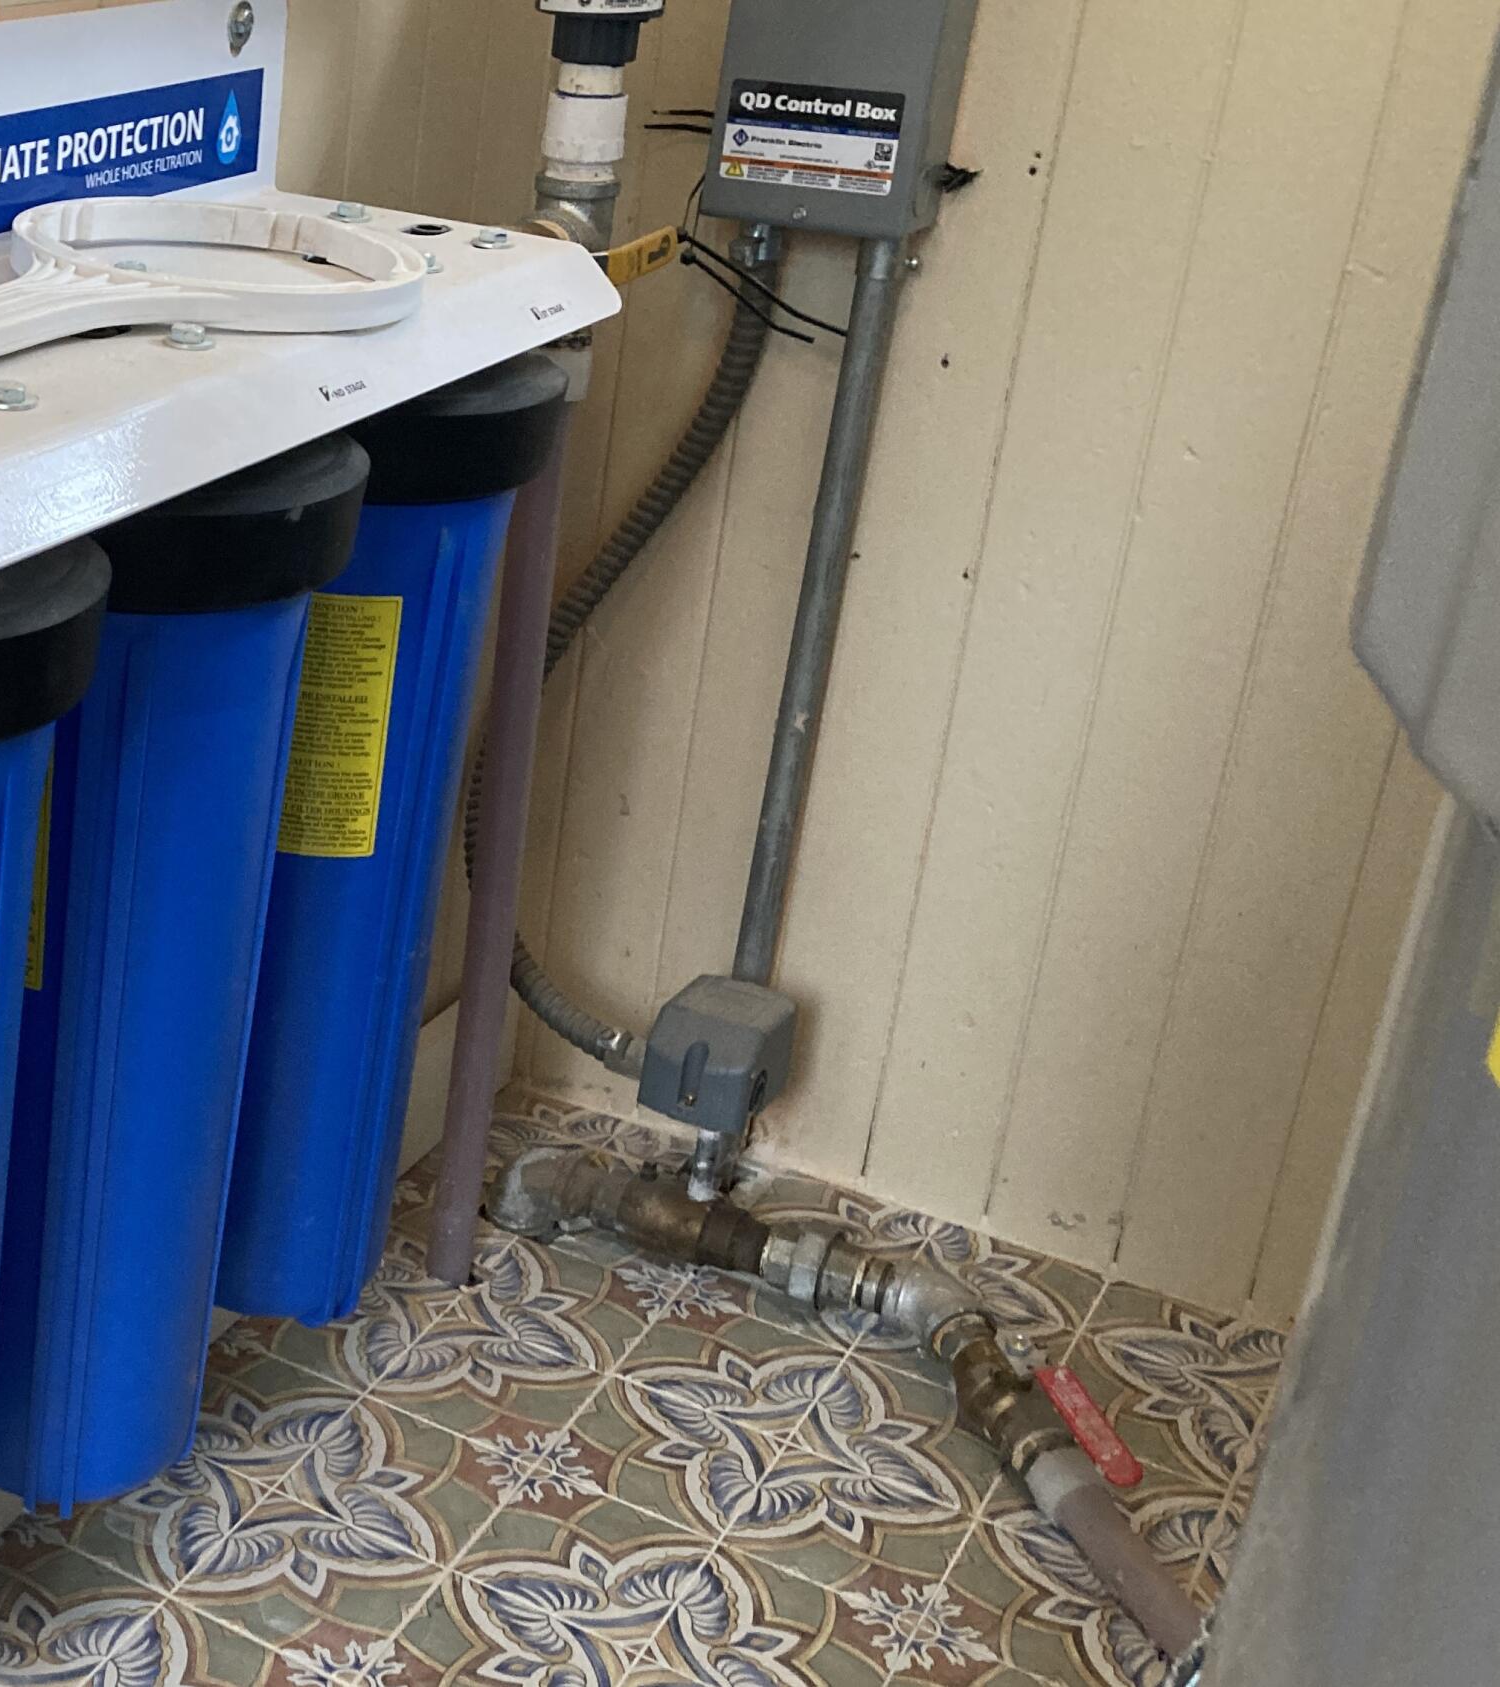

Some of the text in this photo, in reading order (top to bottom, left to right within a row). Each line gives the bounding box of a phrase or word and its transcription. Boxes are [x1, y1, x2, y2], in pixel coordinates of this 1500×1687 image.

[739, 91, 898, 122] QD Control Box
[56, 107, 205, 171] PROTECTION
[84, 149, 203, 189] WHOLE HOUSE FILTRATION
